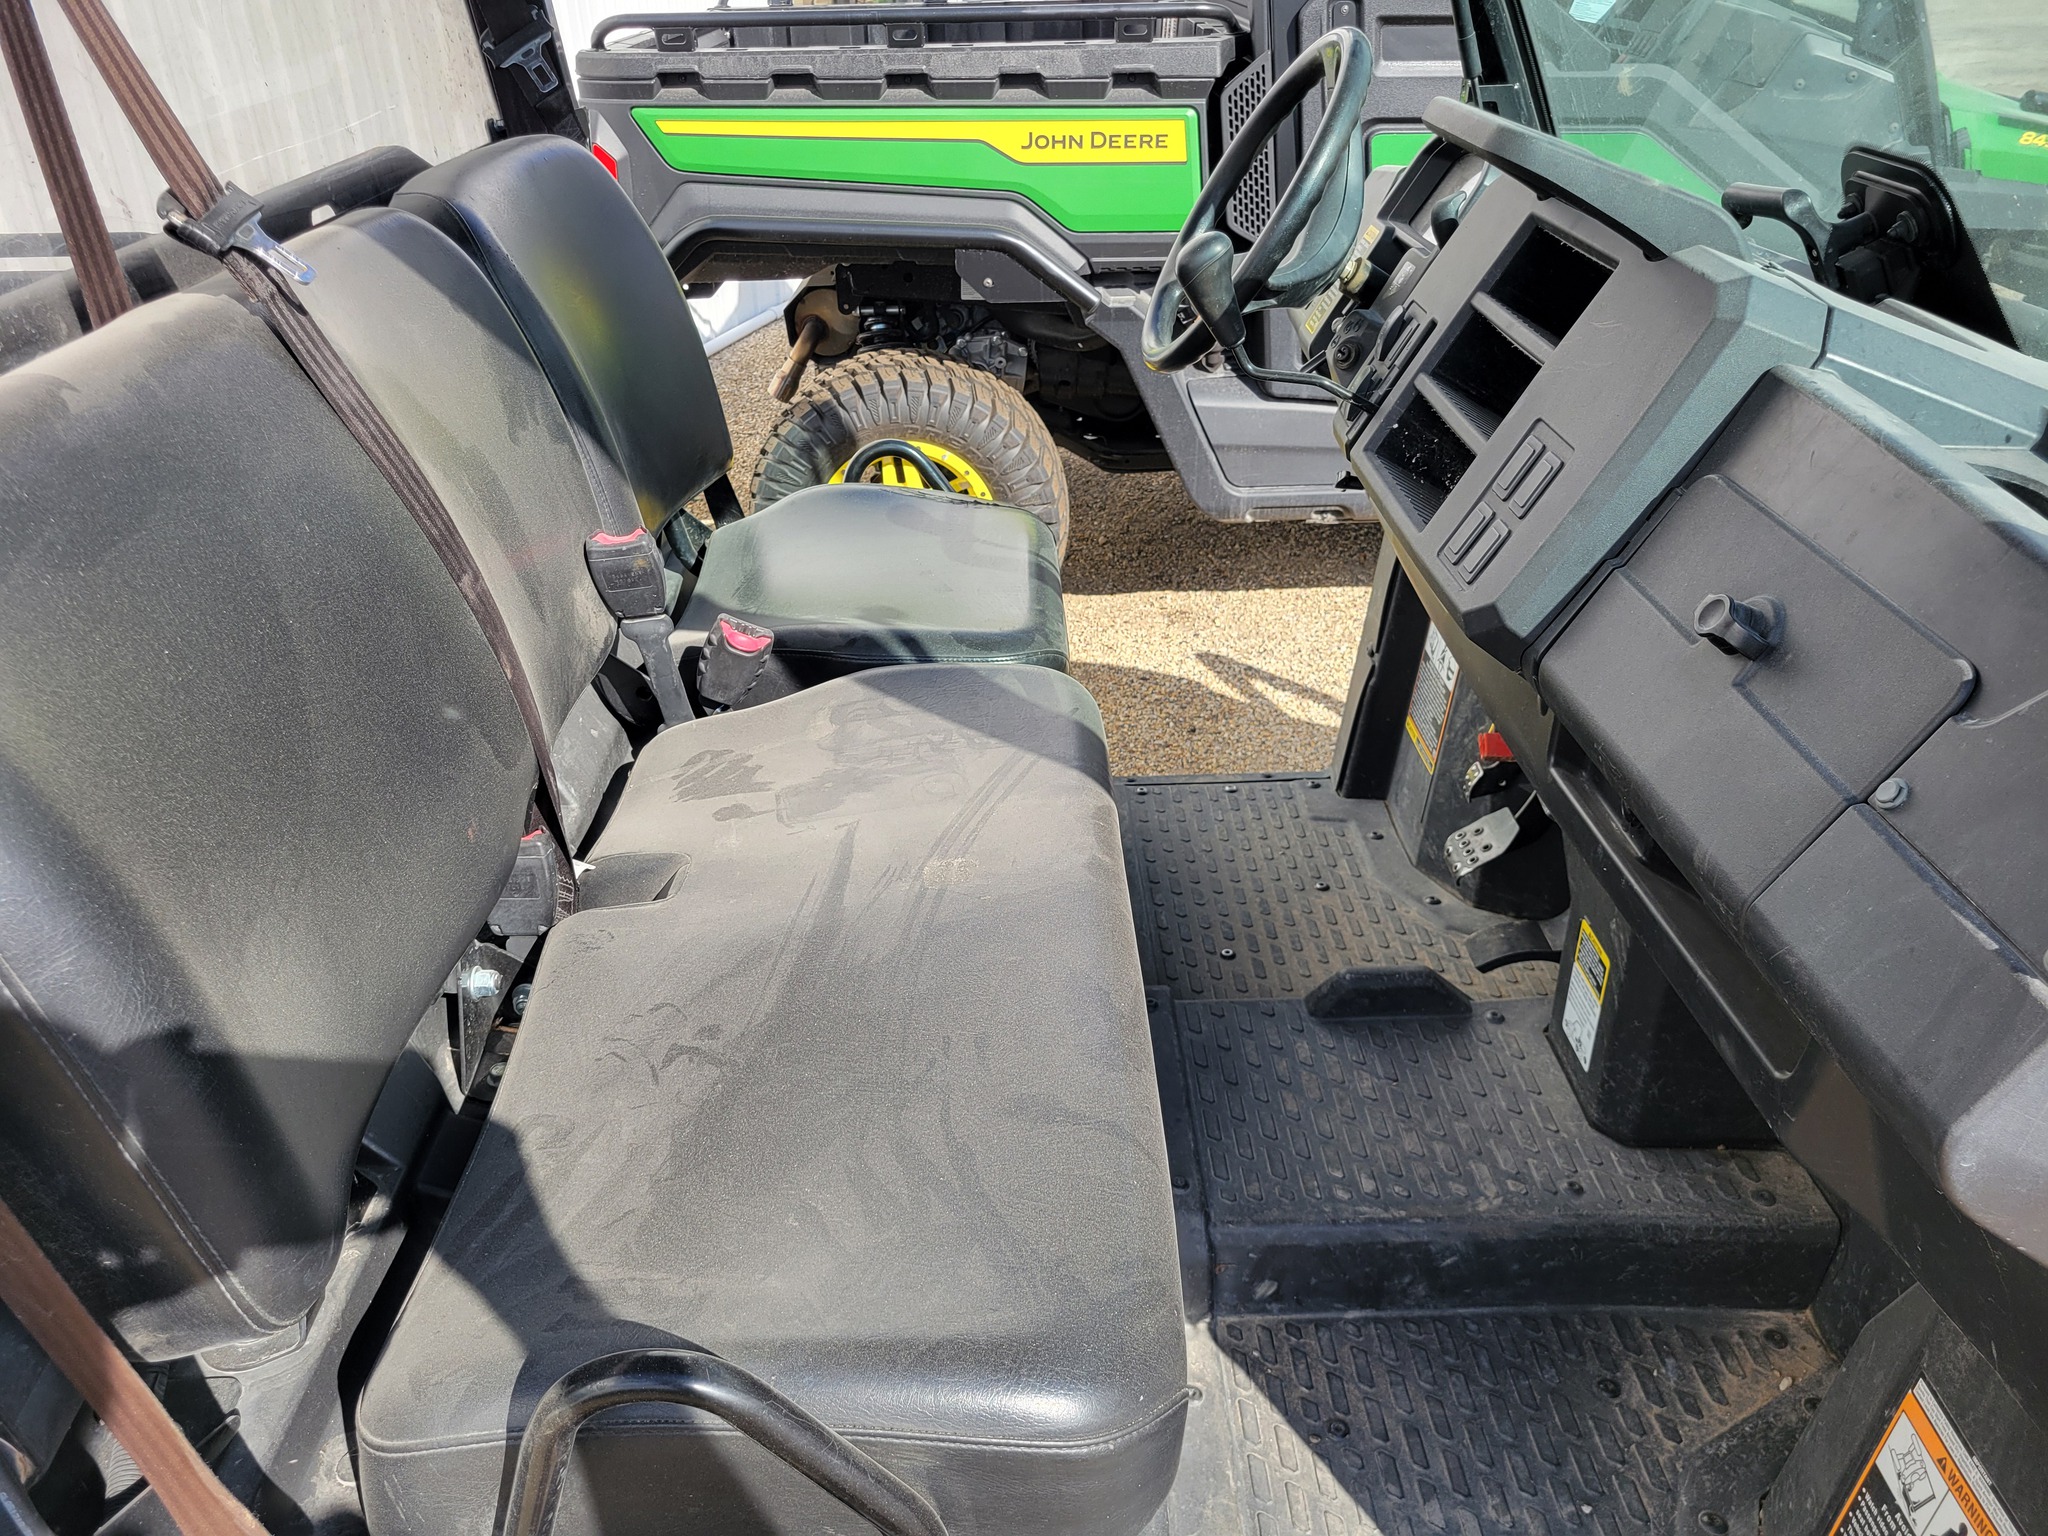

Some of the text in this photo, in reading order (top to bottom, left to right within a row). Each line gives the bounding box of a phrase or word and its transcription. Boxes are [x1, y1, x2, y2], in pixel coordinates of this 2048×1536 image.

[1021, 132, 1168, 149] JOHN DEERE
[2019, 131, 2048, 149] 84
[1881, 1503, 1896, 1531] From
